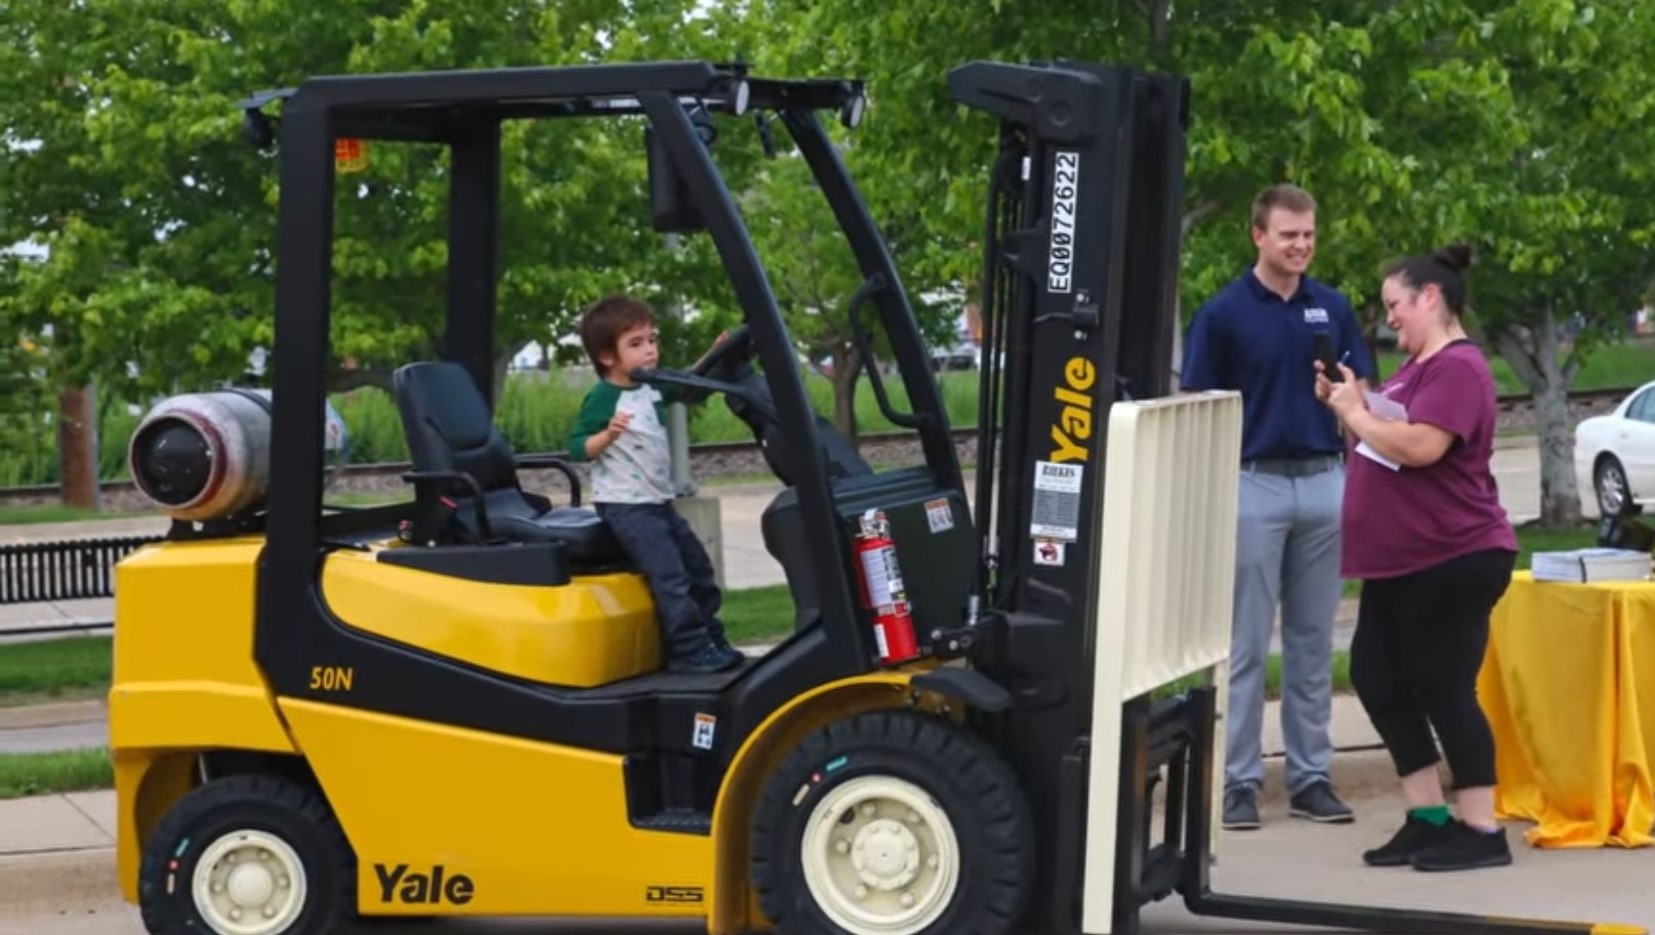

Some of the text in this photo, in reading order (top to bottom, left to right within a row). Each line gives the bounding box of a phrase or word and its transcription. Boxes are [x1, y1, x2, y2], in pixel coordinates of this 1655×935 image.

[1050, 154, 1076, 290] EQ0072622
[1050, 356, 1096, 464] Yale
[310, 666, 353, 690] 50N
[373, 864, 475, 905] Yale
